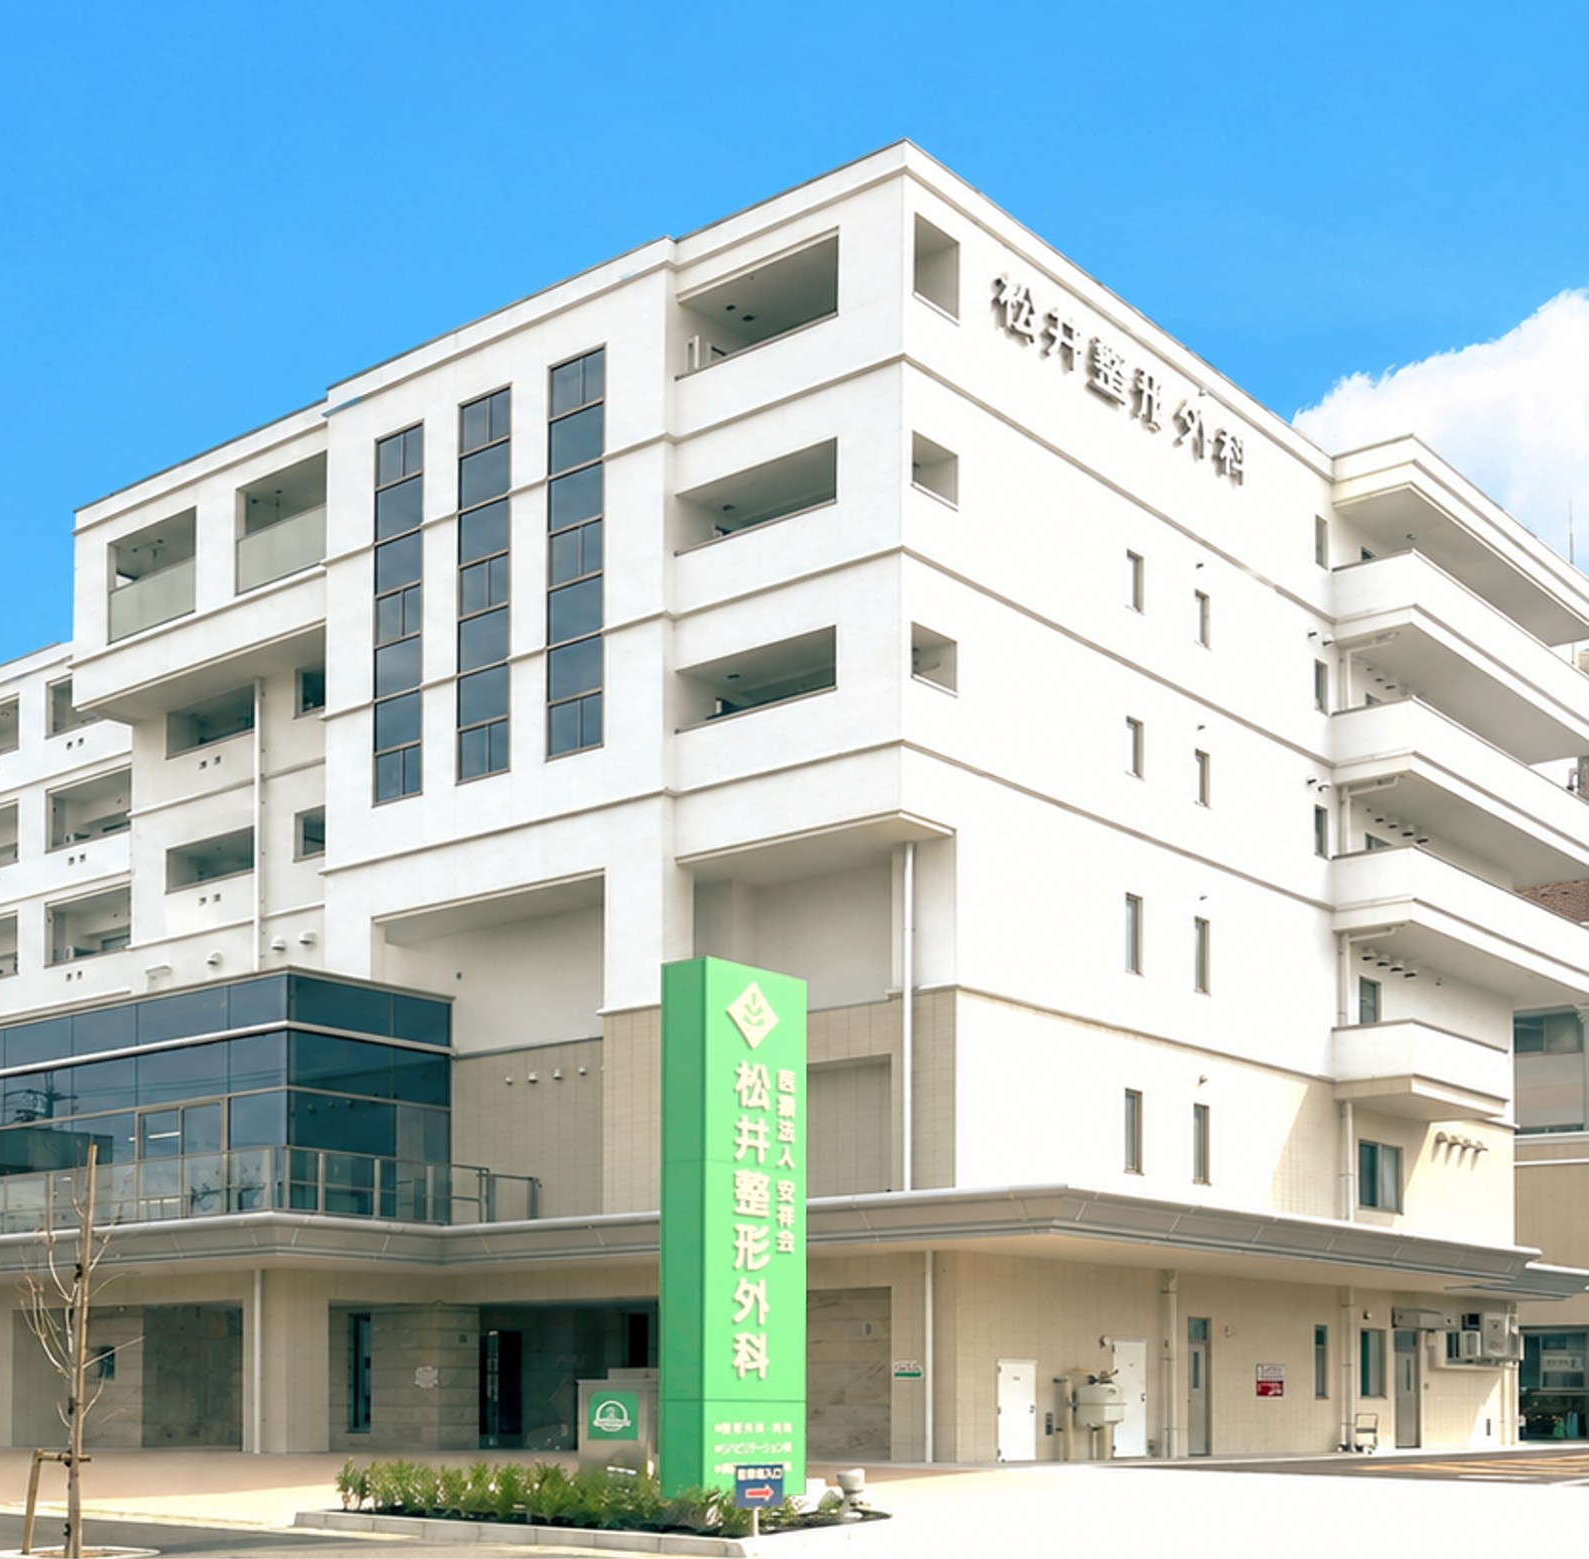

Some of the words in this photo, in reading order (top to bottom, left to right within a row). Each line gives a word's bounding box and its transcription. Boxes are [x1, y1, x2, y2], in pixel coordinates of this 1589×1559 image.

[990, 271, 1244, 488] 松井整形外科
[777, 1069, 796, 1169] 医療法人
[733, 1060, 771, 1379] 松井整形外科
[777, 1180, 796, 1254] 安祥会
